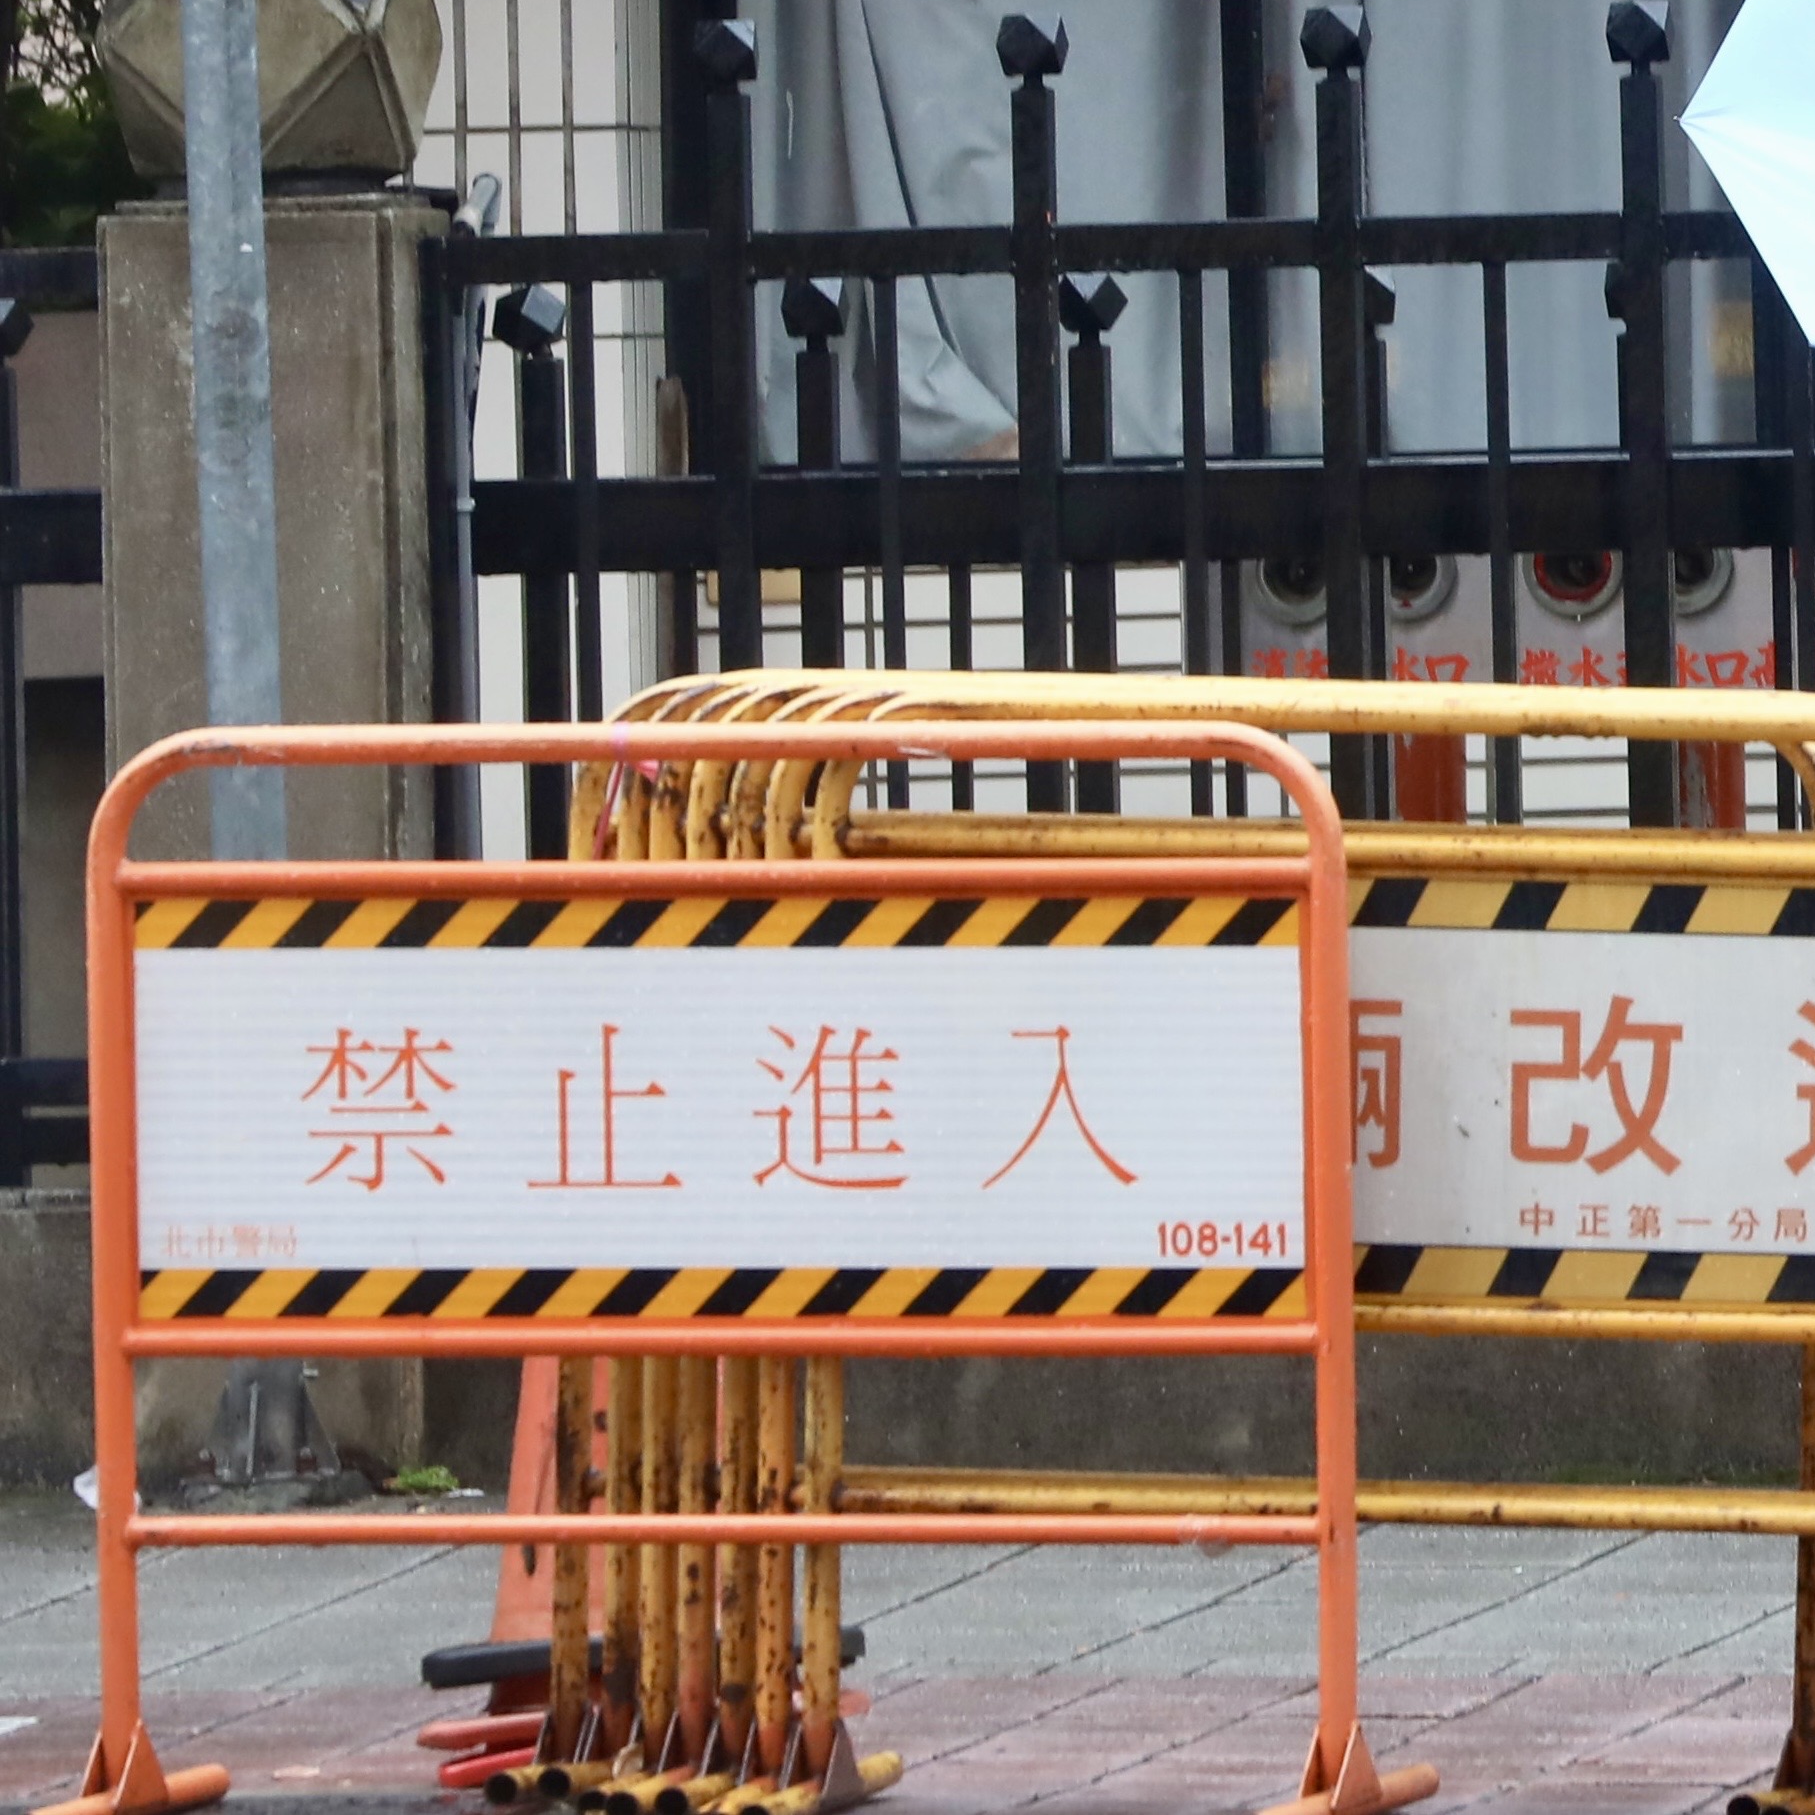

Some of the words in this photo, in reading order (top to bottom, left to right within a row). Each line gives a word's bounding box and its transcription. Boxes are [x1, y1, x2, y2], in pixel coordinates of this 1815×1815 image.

[301, 1022, 1139, 1191] 禁止進入
[1158, 1222, 1287, 1257] 108-141
